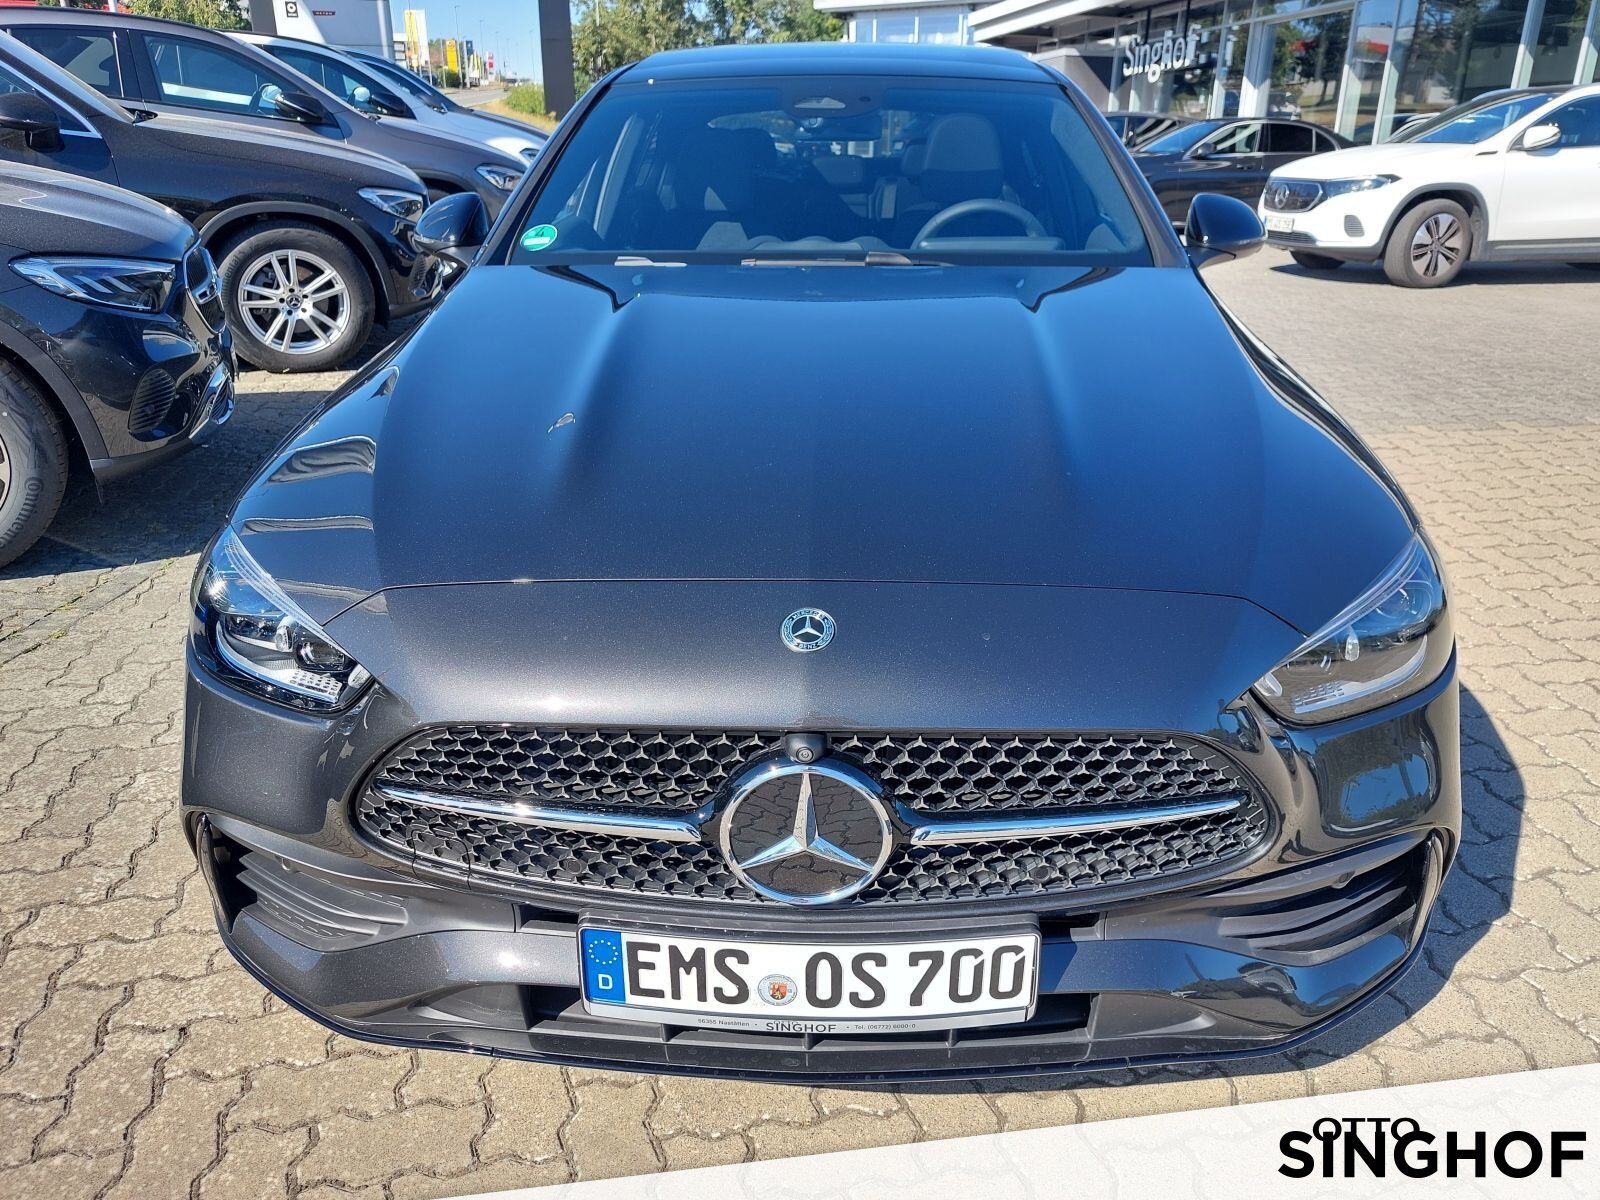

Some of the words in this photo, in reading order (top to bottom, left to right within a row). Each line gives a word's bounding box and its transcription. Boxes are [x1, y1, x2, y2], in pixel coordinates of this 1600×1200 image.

[1122, 24, 1201, 83] Singhof
[598, 973, 613, 990] D
[626, 940, 750, 1005] EMS
[805, 951, 887, 1009] OS
[908, 944, 1026, 1007] 700
[766, 1021, 837, 1033] SINGHOF
